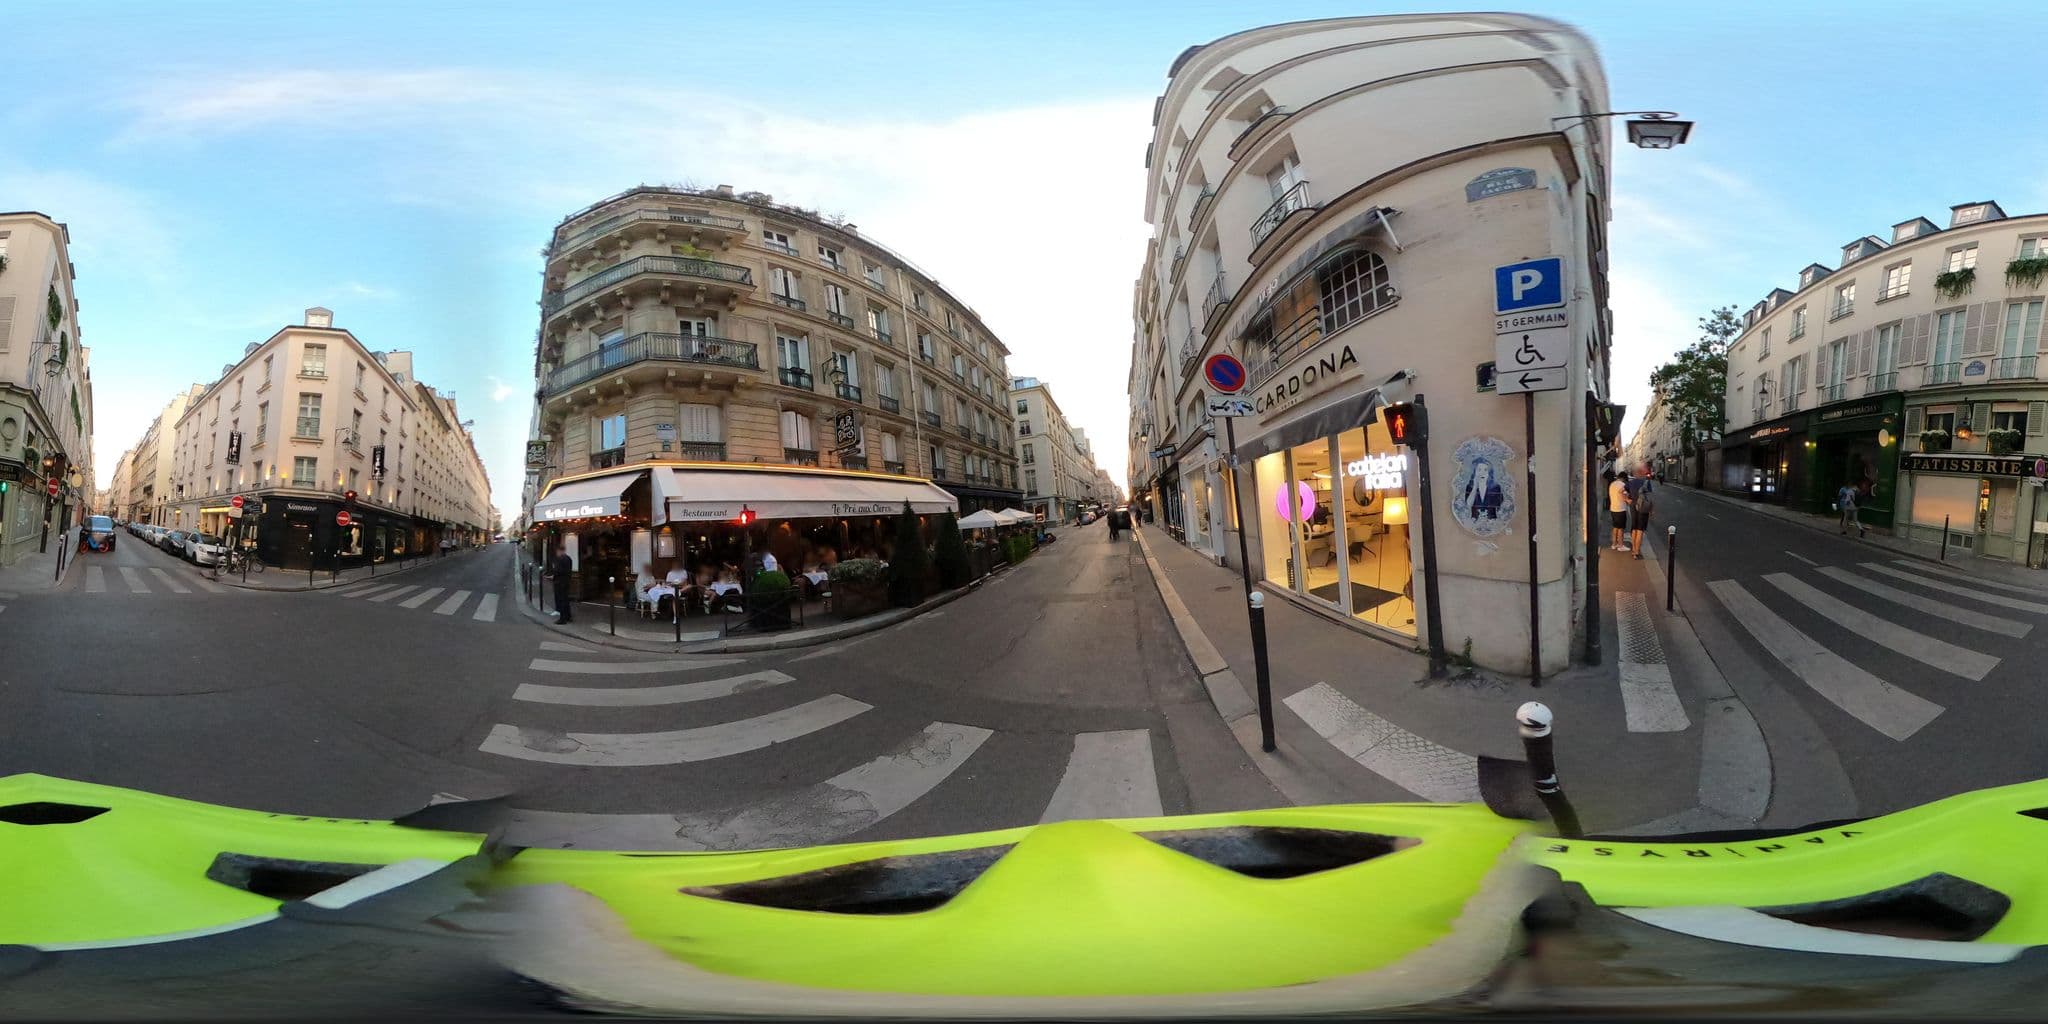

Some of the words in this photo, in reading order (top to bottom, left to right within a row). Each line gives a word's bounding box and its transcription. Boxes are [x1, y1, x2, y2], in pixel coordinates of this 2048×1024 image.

[1511, 268, 1544, 301] P
[1496, 319, 1510, 329] ST
[1512, 312, 1566, 327] GERMAIN
[1255, 344, 1358, 415] CARDONA
[1911, 459, 2021, 475] PATISSERIE
[682, 508, 728, 518] Restaurant
[831, 503, 841, 516] Le
